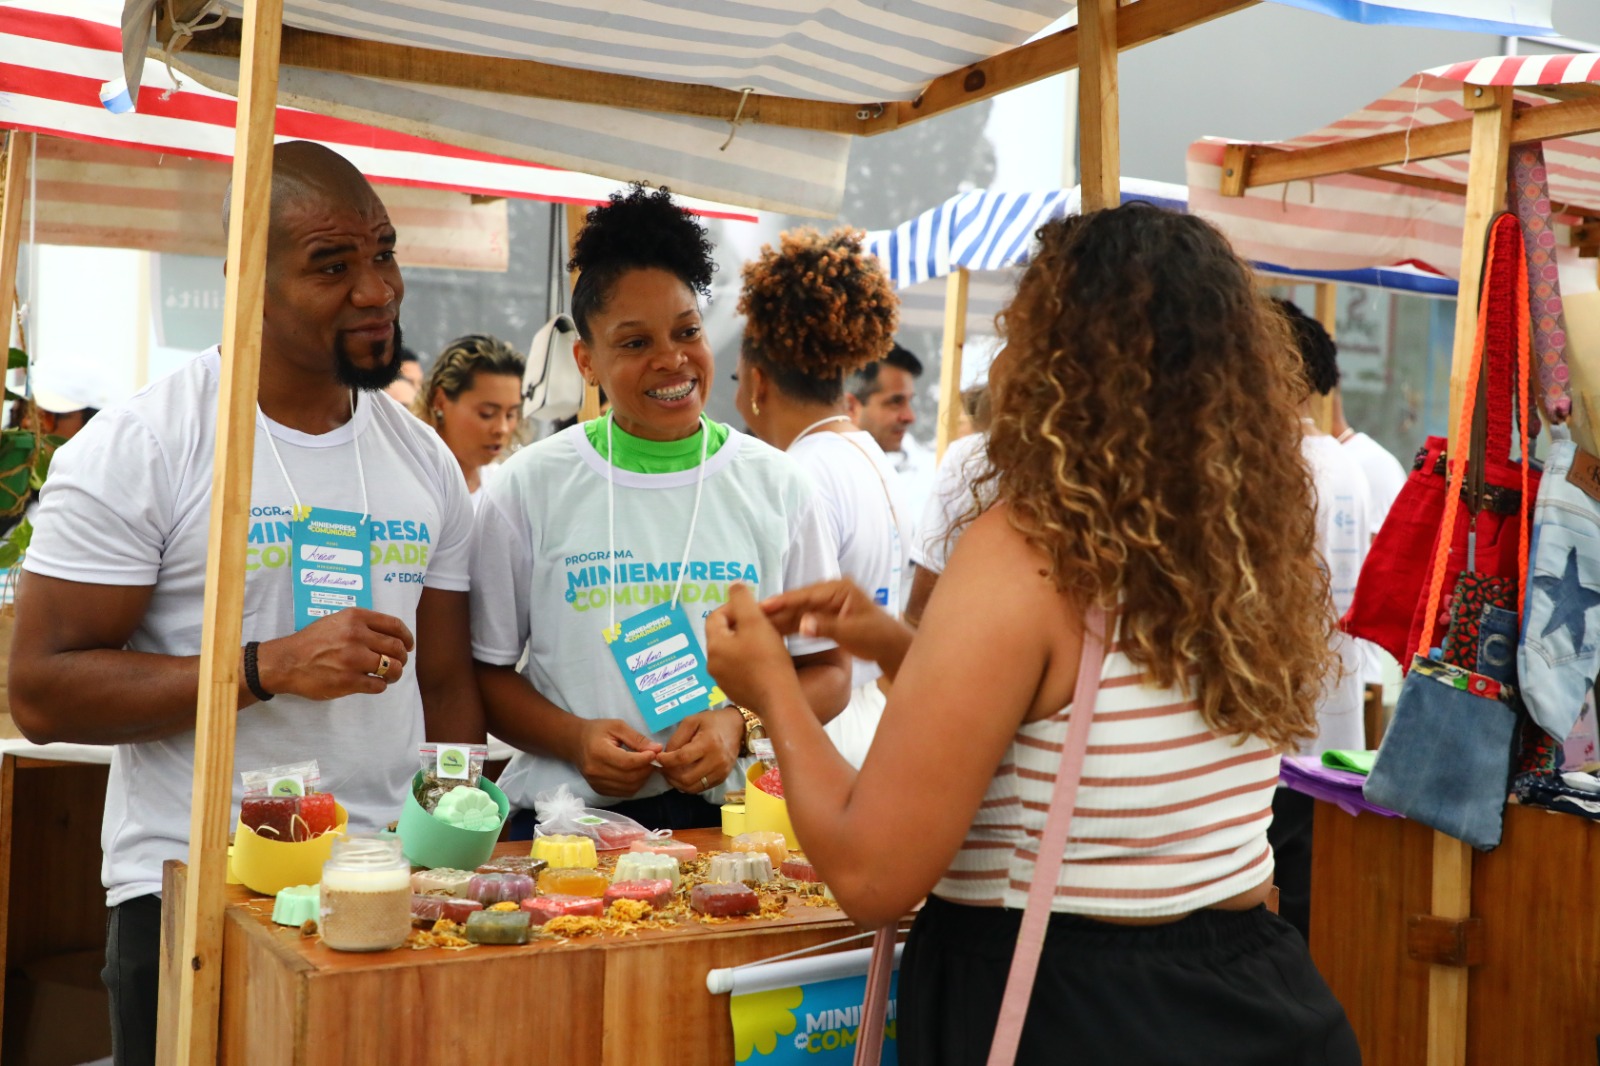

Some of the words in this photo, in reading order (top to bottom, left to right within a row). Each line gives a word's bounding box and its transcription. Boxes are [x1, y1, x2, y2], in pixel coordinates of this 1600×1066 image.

[310, 520, 356, 532] MINIEMPRESA
[311, 527, 356, 537] COMUNIDADE
[565, 550, 633, 566] PROGRAMA
[567, 561, 759, 588] MINIEMPRESA
[627, 619, 672, 642] COMUNIDADE
